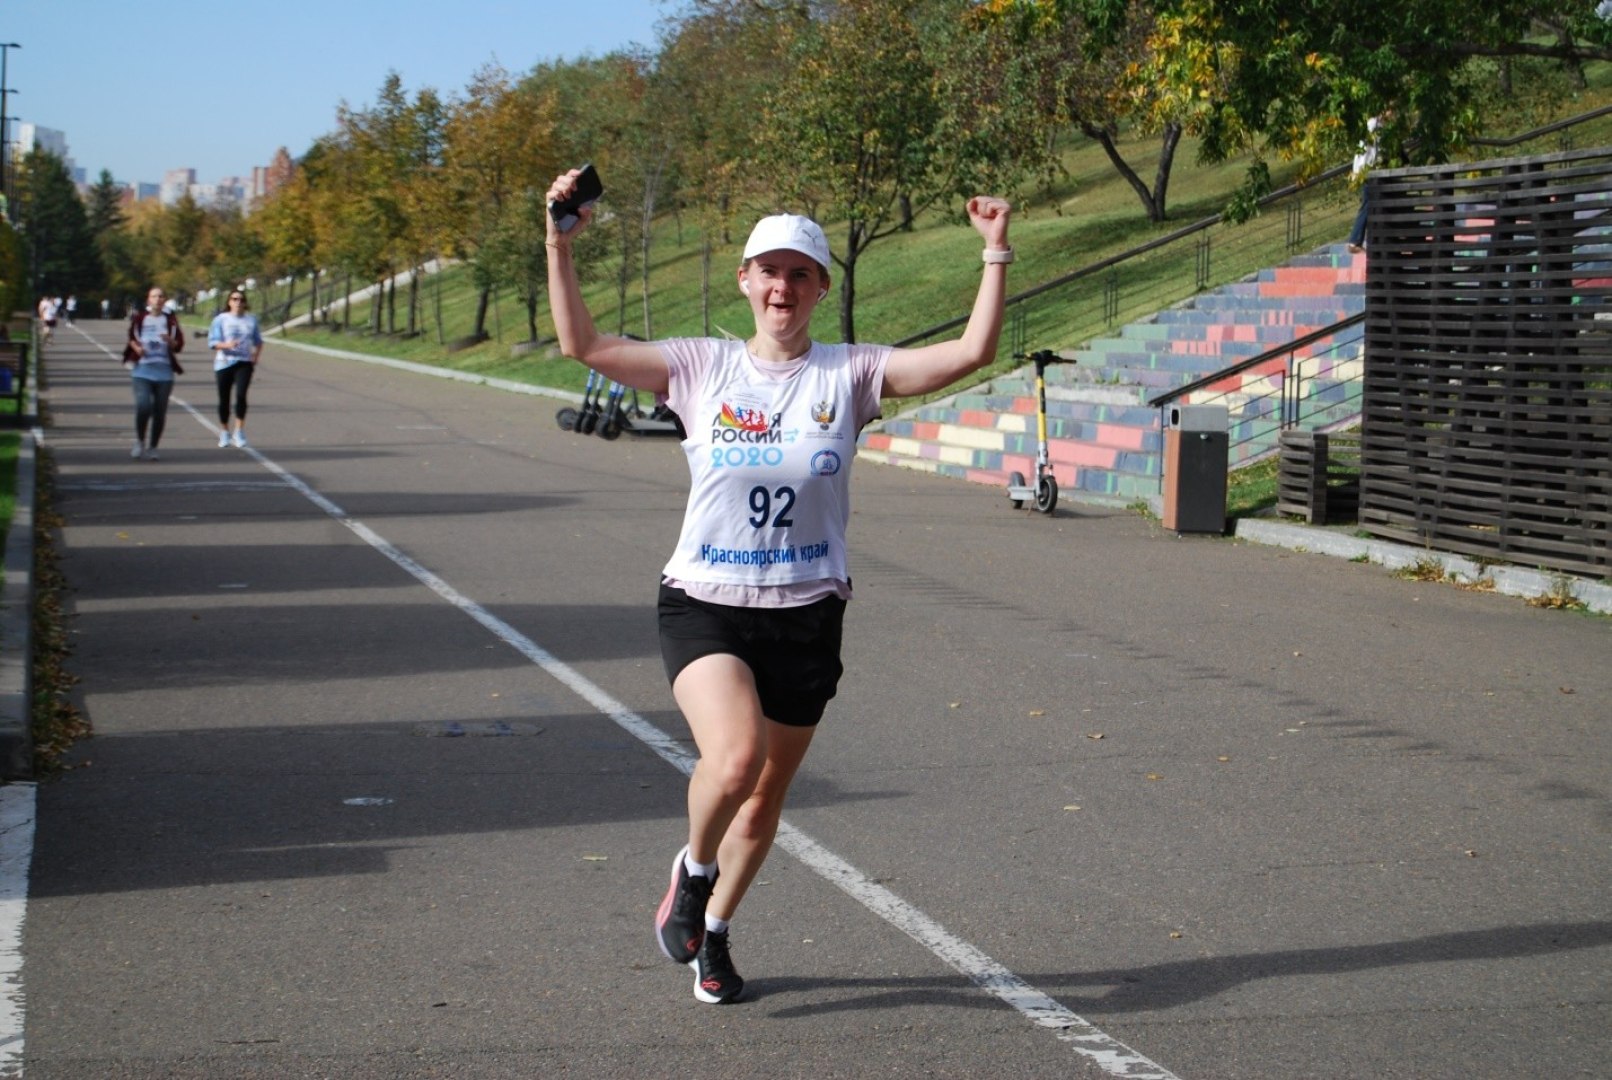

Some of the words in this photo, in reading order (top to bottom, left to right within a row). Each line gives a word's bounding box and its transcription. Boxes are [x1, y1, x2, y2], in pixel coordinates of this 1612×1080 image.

[712, 428, 782, 444] РОССИИ
[711, 446, 784, 468] 2020
[748, 485, 796, 529] 92
[701, 544, 797, 568] Красноярский
[800, 540, 829, 563] край
